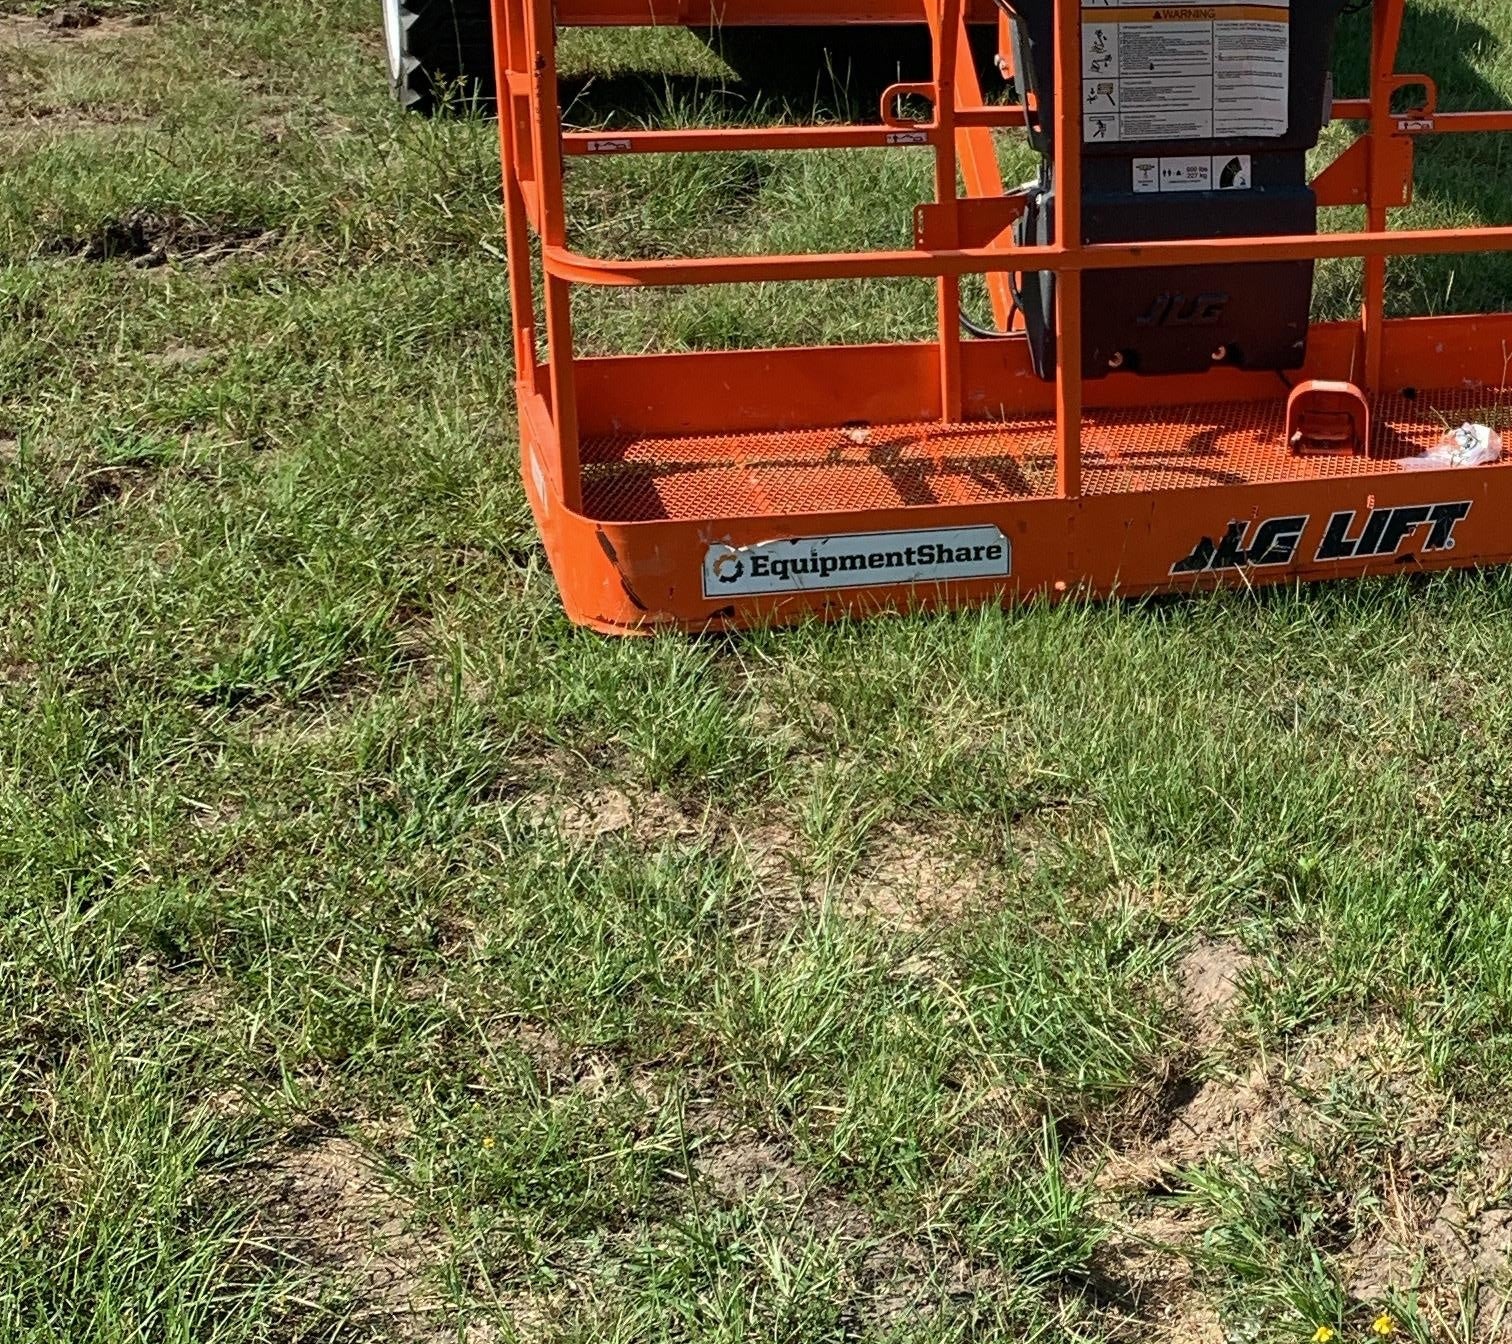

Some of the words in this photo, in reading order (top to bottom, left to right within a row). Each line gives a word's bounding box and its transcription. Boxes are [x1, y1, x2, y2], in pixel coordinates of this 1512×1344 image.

[1162, 8, 1216, 20] WARNING
[1313, 500, 1474, 561] LIFT
[749, 544, 1003, 580] EquipmentShare
